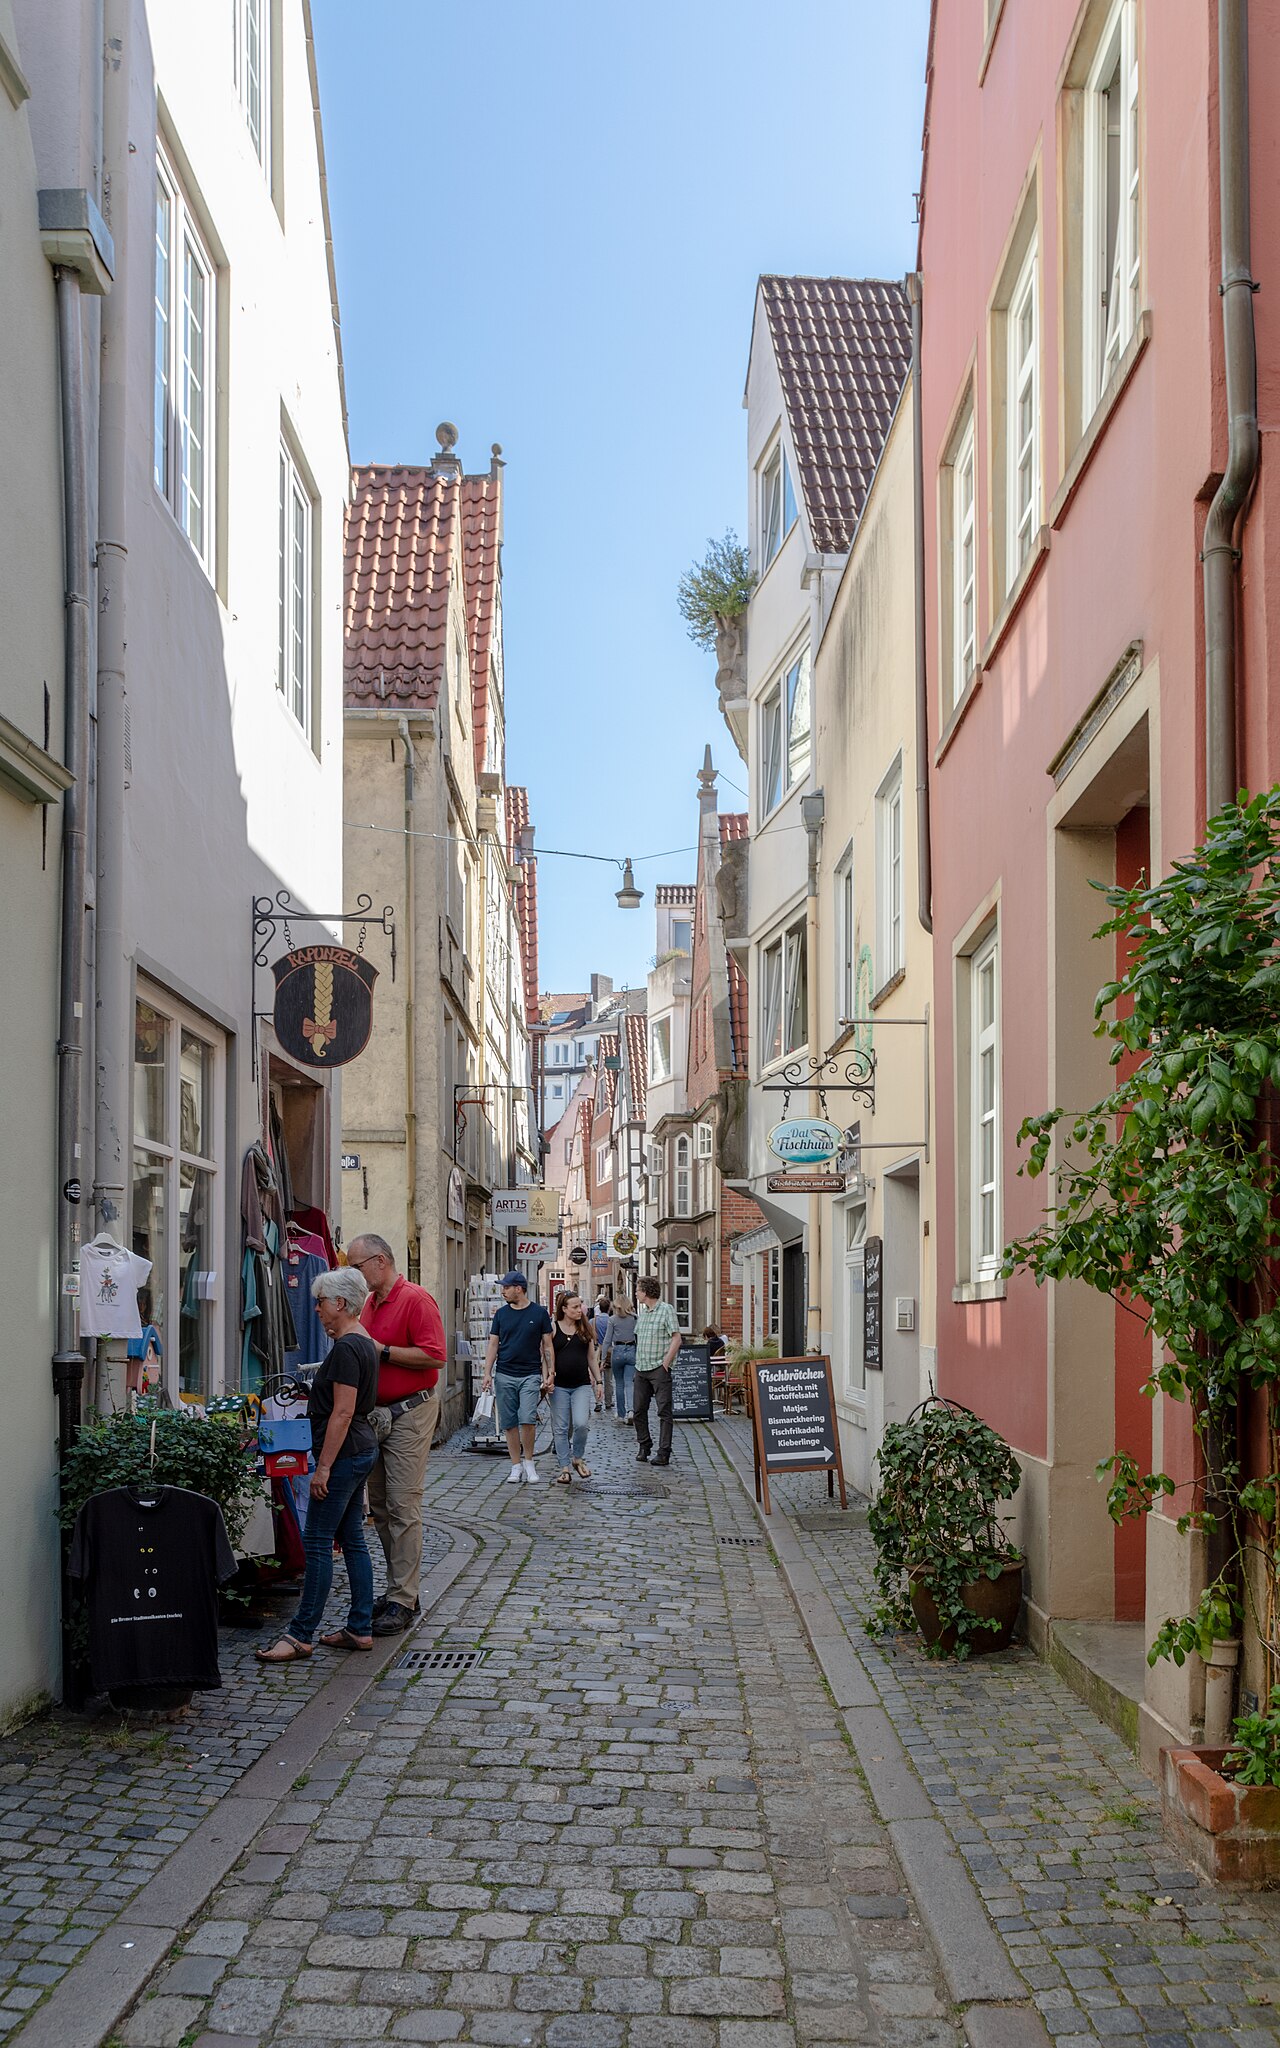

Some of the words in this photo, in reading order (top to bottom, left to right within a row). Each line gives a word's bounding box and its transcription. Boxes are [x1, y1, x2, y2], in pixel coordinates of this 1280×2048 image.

[287, 947, 359, 970] RAPUNZEL
[790, 1128, 809, 1138] Dat
[517, 1242, 539, 1254] EIS
[758, 1368, 825, 1383] Fischbrötchen
[768, 1384, 803, 1392] Backfisch
[805, 1383, 818, 1391] mit
[768, 1391, 819, 1400] Kartoffelsalat
[782, 1404, 808, 1413] Matjes
[768, 1415, 825, 1425] Bismarckhering
[771, 1426, 824, 1436] Fischfrikadelle
[778, 1438, 820, 1447] Kieberlinge
